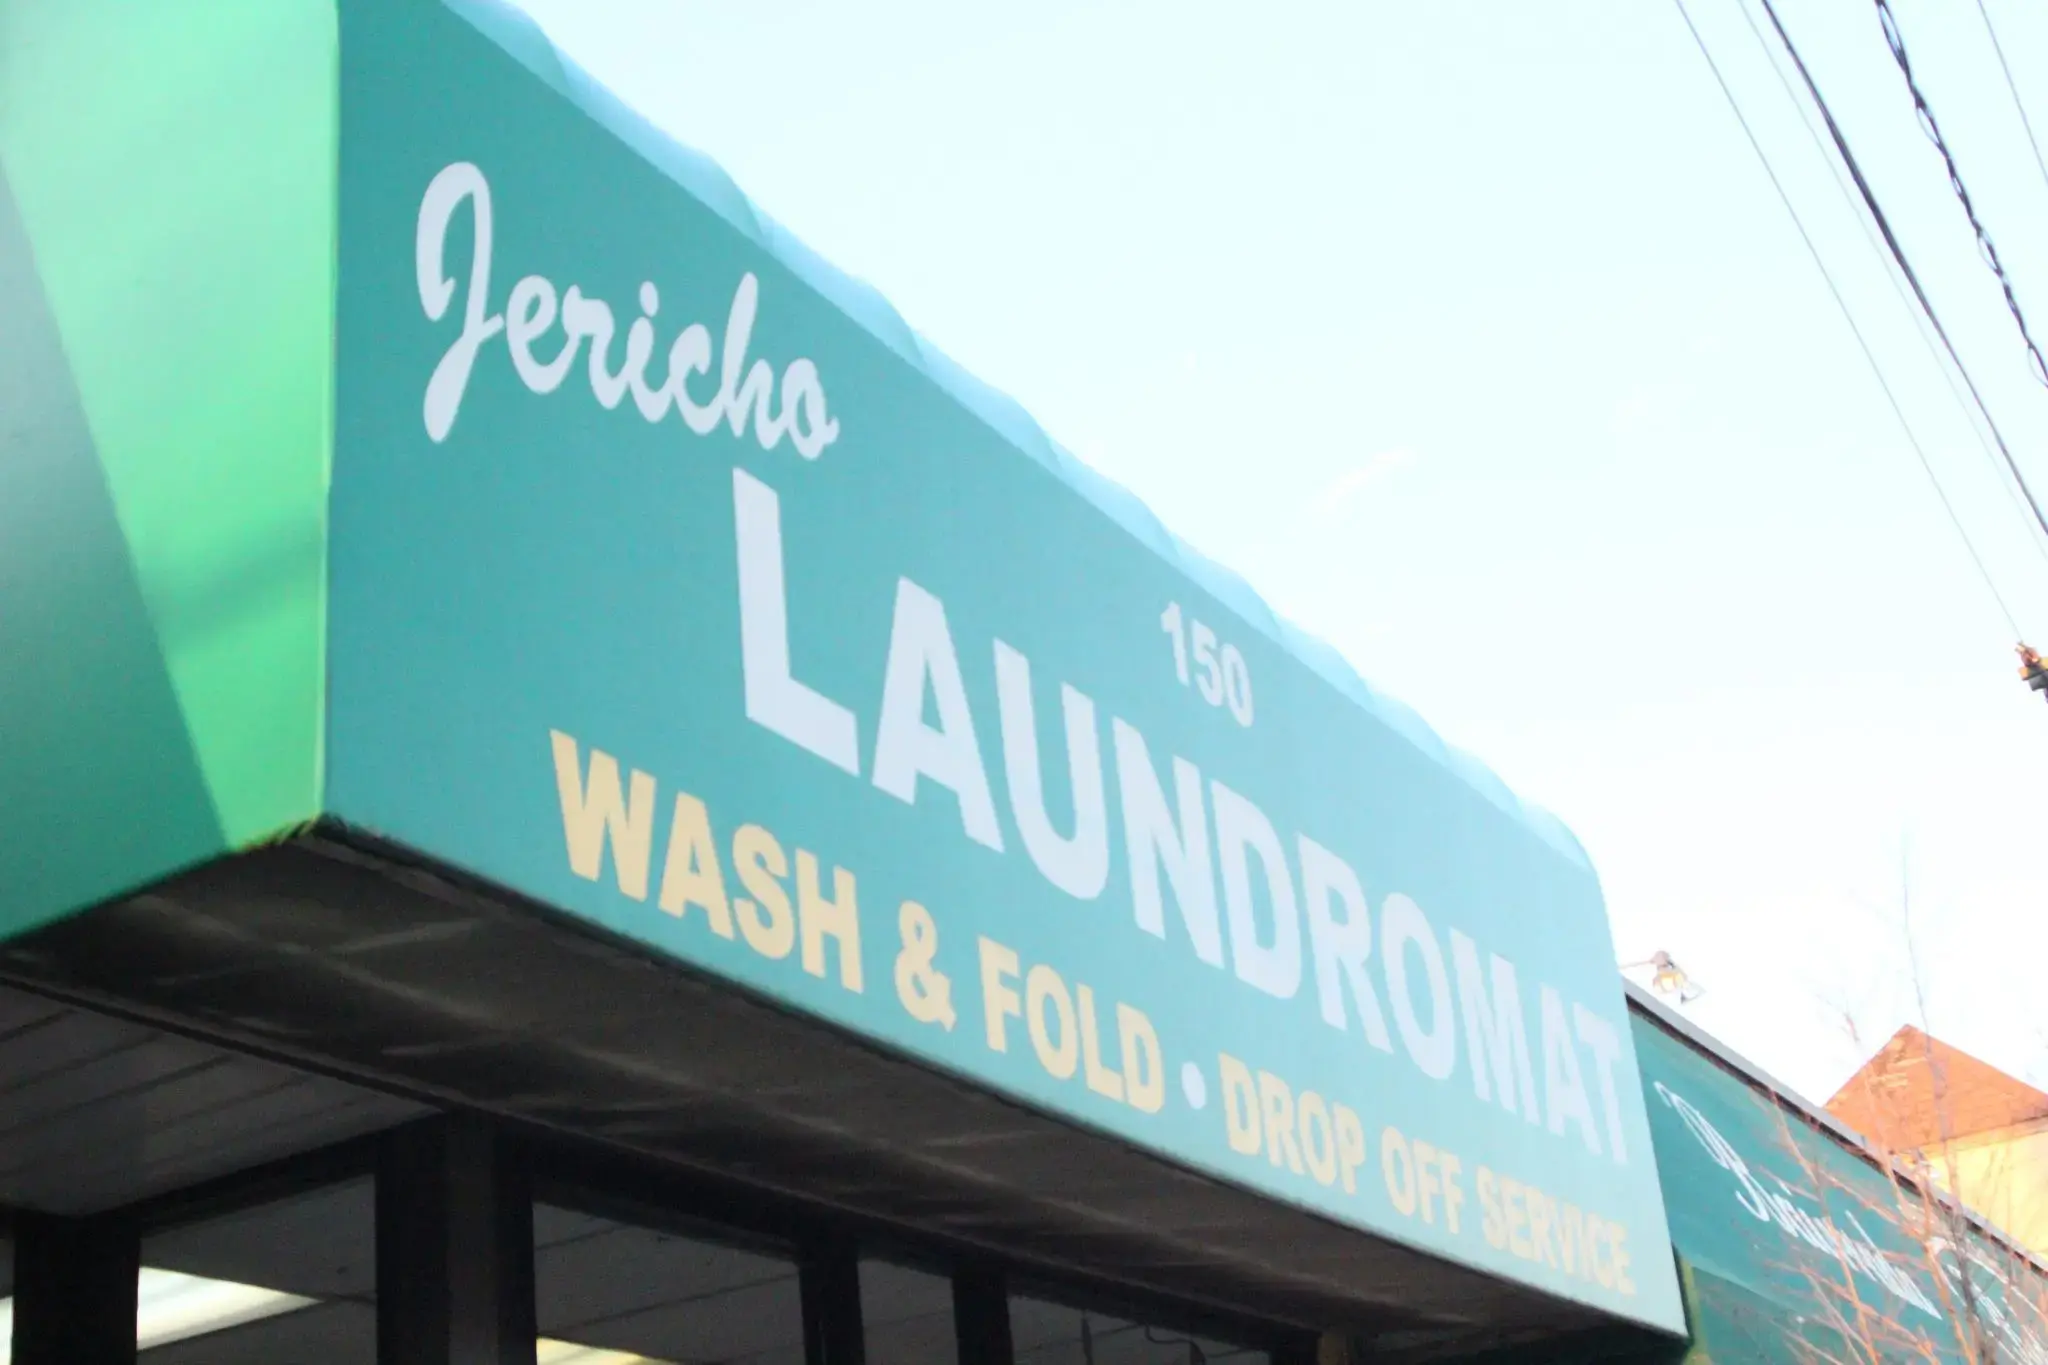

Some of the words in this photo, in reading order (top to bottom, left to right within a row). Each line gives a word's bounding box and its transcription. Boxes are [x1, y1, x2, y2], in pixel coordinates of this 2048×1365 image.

[416, 161, 839, 460] Jericho
[733, 467, 1627, 1165] LAUNDROMAT
[1161, 601, 1253, 728] 150
[549, 729, 863, 994] WASH
[895, 901, 956, 1032] &
[978, 935, 1165, 1114] FOLD
[1219, 1052, 1365, 1195] DROP
[1381, 1127, 1463, 1235] OFF
[1477, 1165, 1635, 1296] SERVICE
